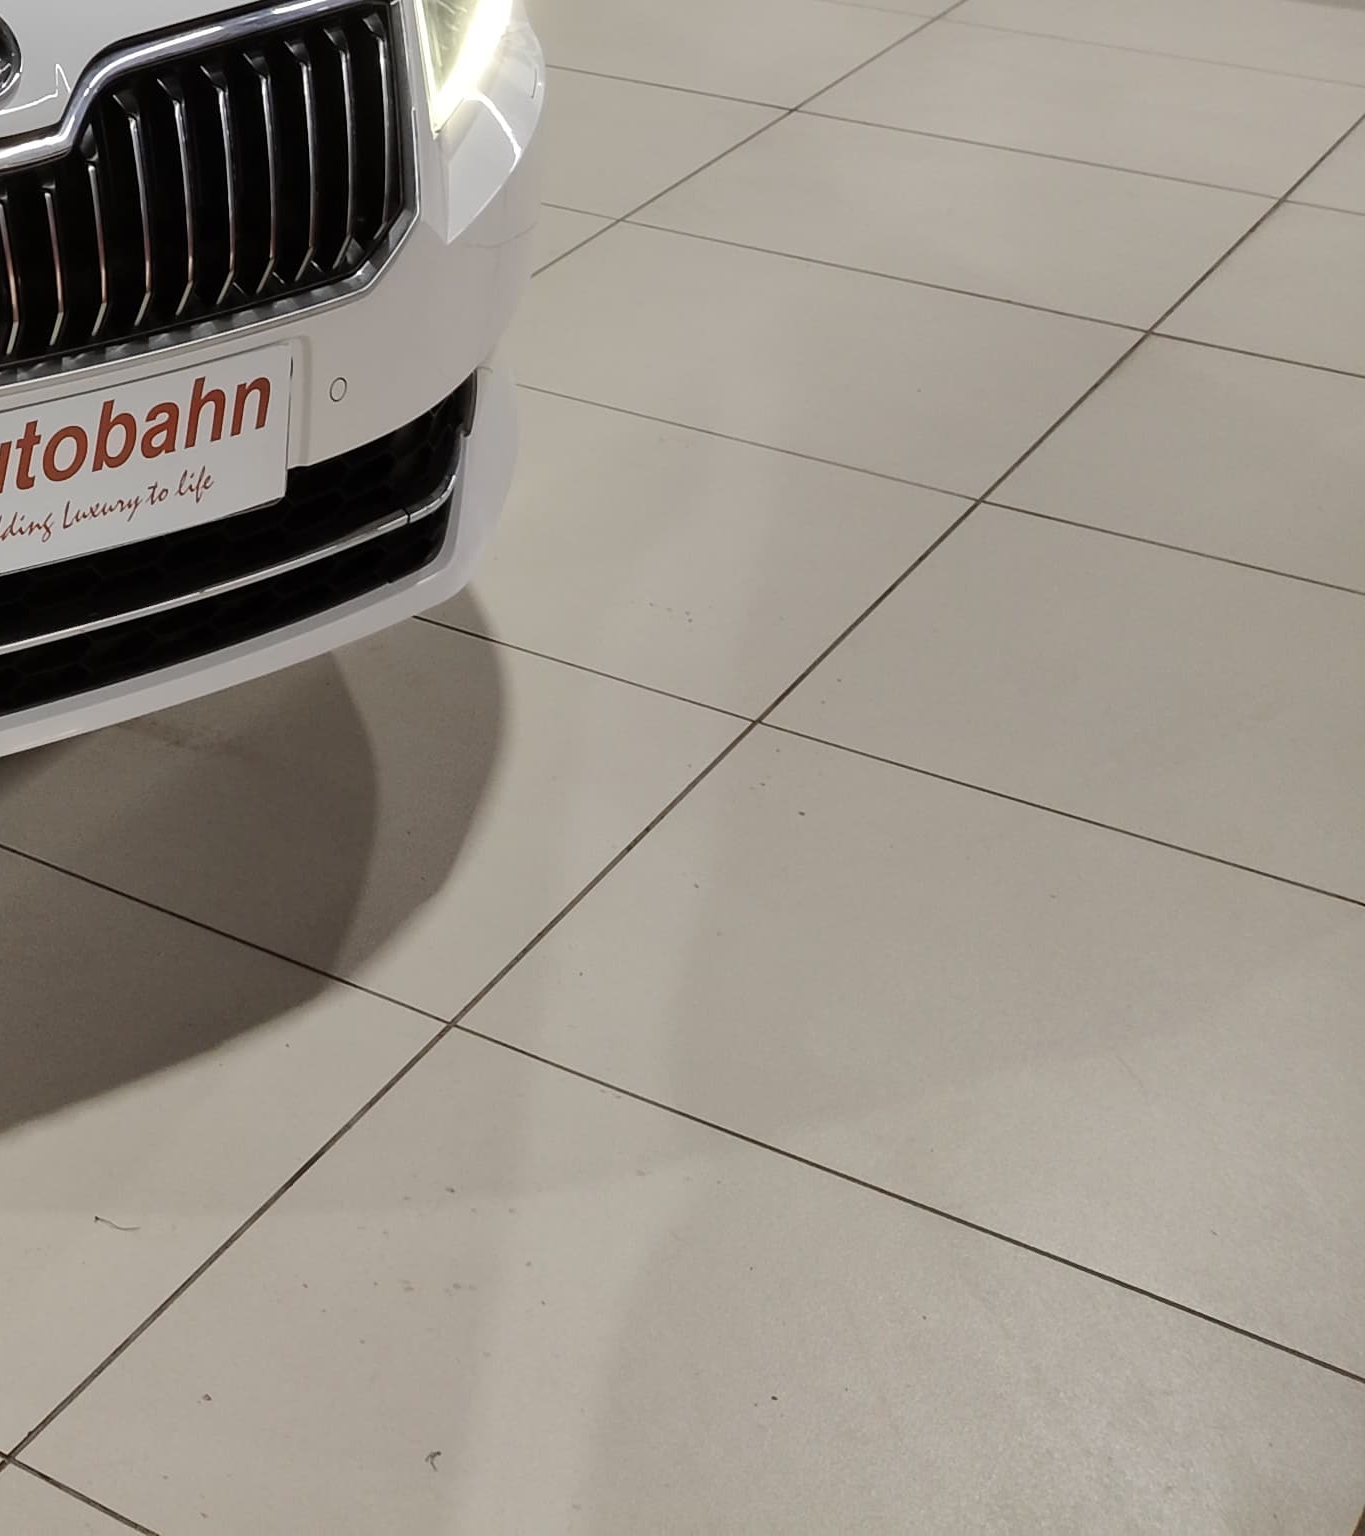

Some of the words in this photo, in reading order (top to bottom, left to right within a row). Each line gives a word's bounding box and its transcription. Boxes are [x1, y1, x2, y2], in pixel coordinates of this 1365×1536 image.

[62, 495, 142, 530] Luxury
[147, 479, 170, 506] to
[176, 465, 215, 504] life
